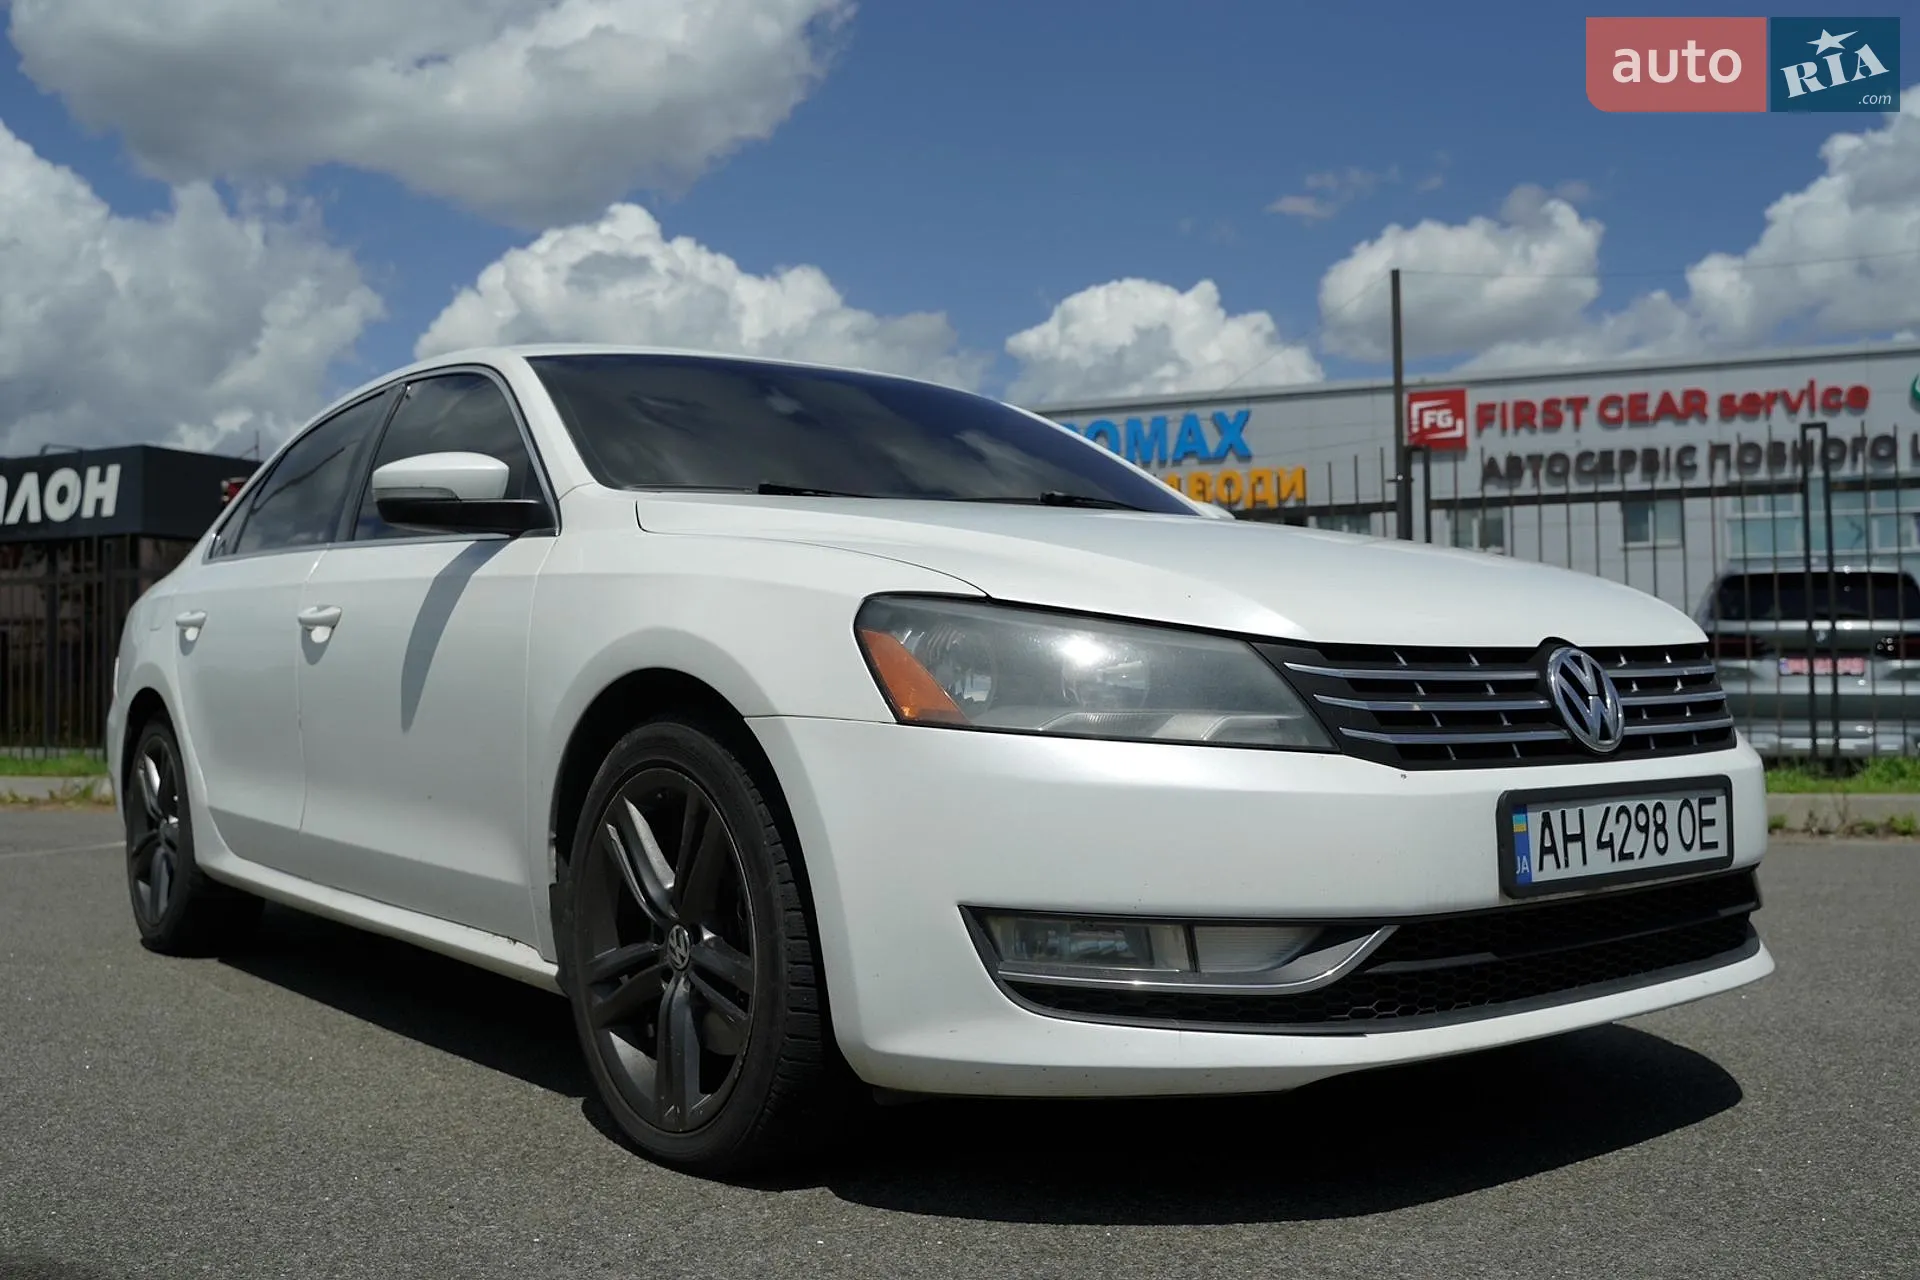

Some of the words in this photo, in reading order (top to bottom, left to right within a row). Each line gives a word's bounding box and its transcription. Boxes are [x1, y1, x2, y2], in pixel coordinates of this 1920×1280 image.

[1422, 408, 1455, 430] FG
[1476, 395, 1589, 435] FIRST
[1597, 388, 1708, 426] GEAR
[1719, 379, 1870, 419] service
[1062, 409, 1252, 462] OMAX
[1482, 444, 1698, 487] АВТОСЕРВІС
[1709, 434, 1896, 475] ПОВНОГО
[1538, 808, 1588, 871] AH
[1596, 800, 1669, 863] 4298
[1676, 796, 1718, 853] OE
